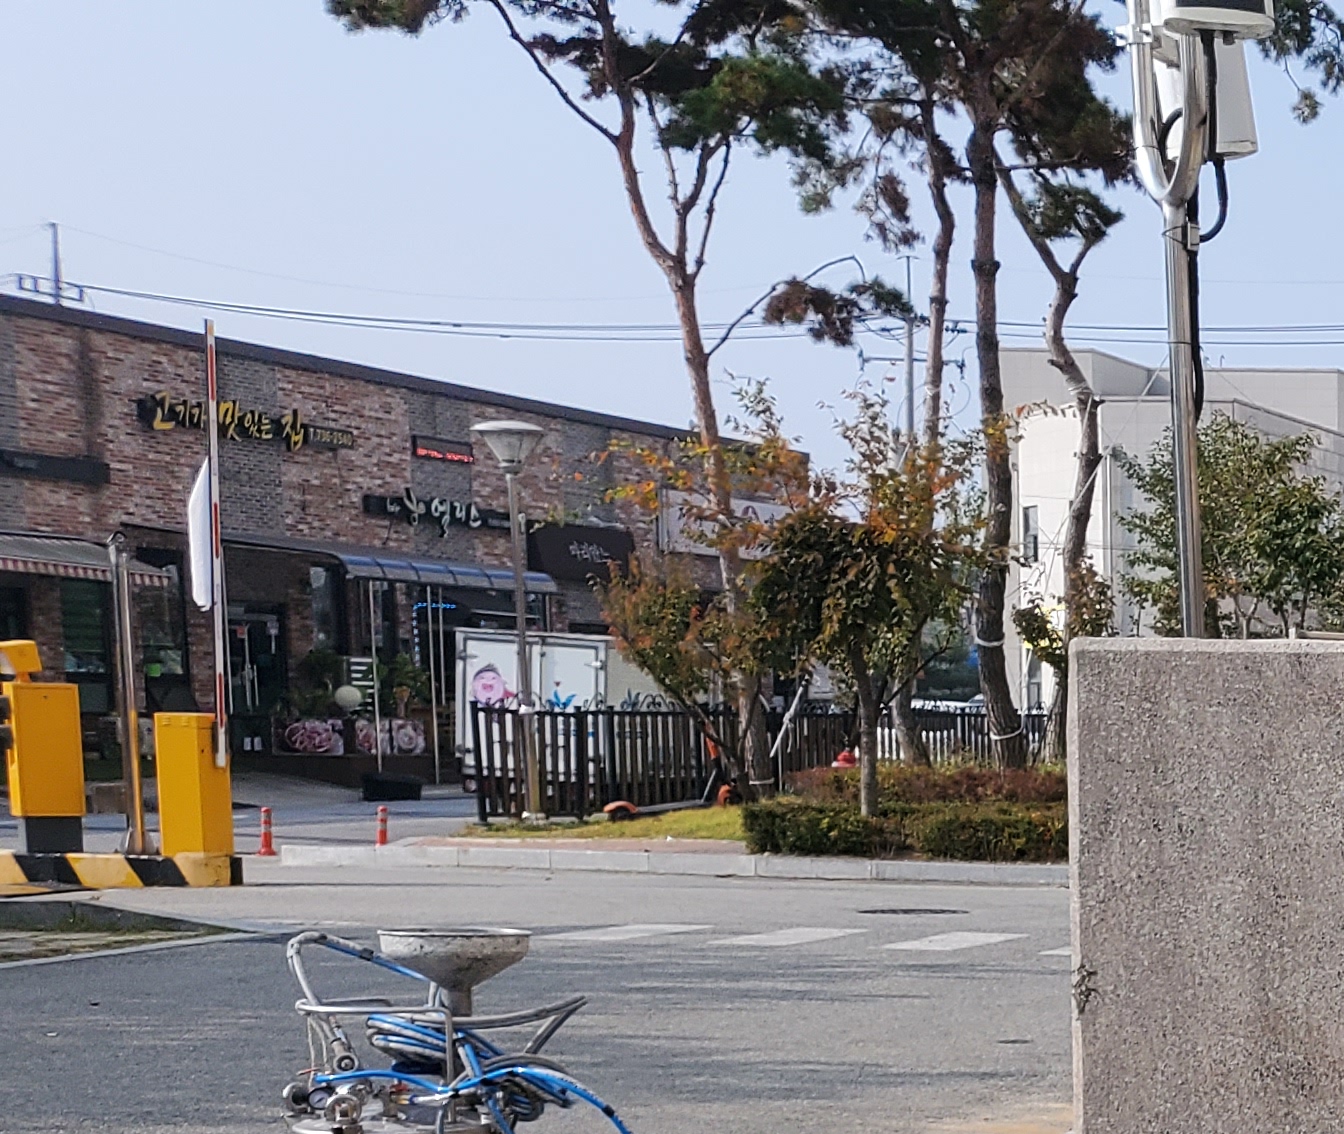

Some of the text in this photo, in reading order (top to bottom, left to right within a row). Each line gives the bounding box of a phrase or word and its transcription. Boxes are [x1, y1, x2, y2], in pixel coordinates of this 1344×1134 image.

[153, 391, 304, 451] 고기가 맛있는 집
